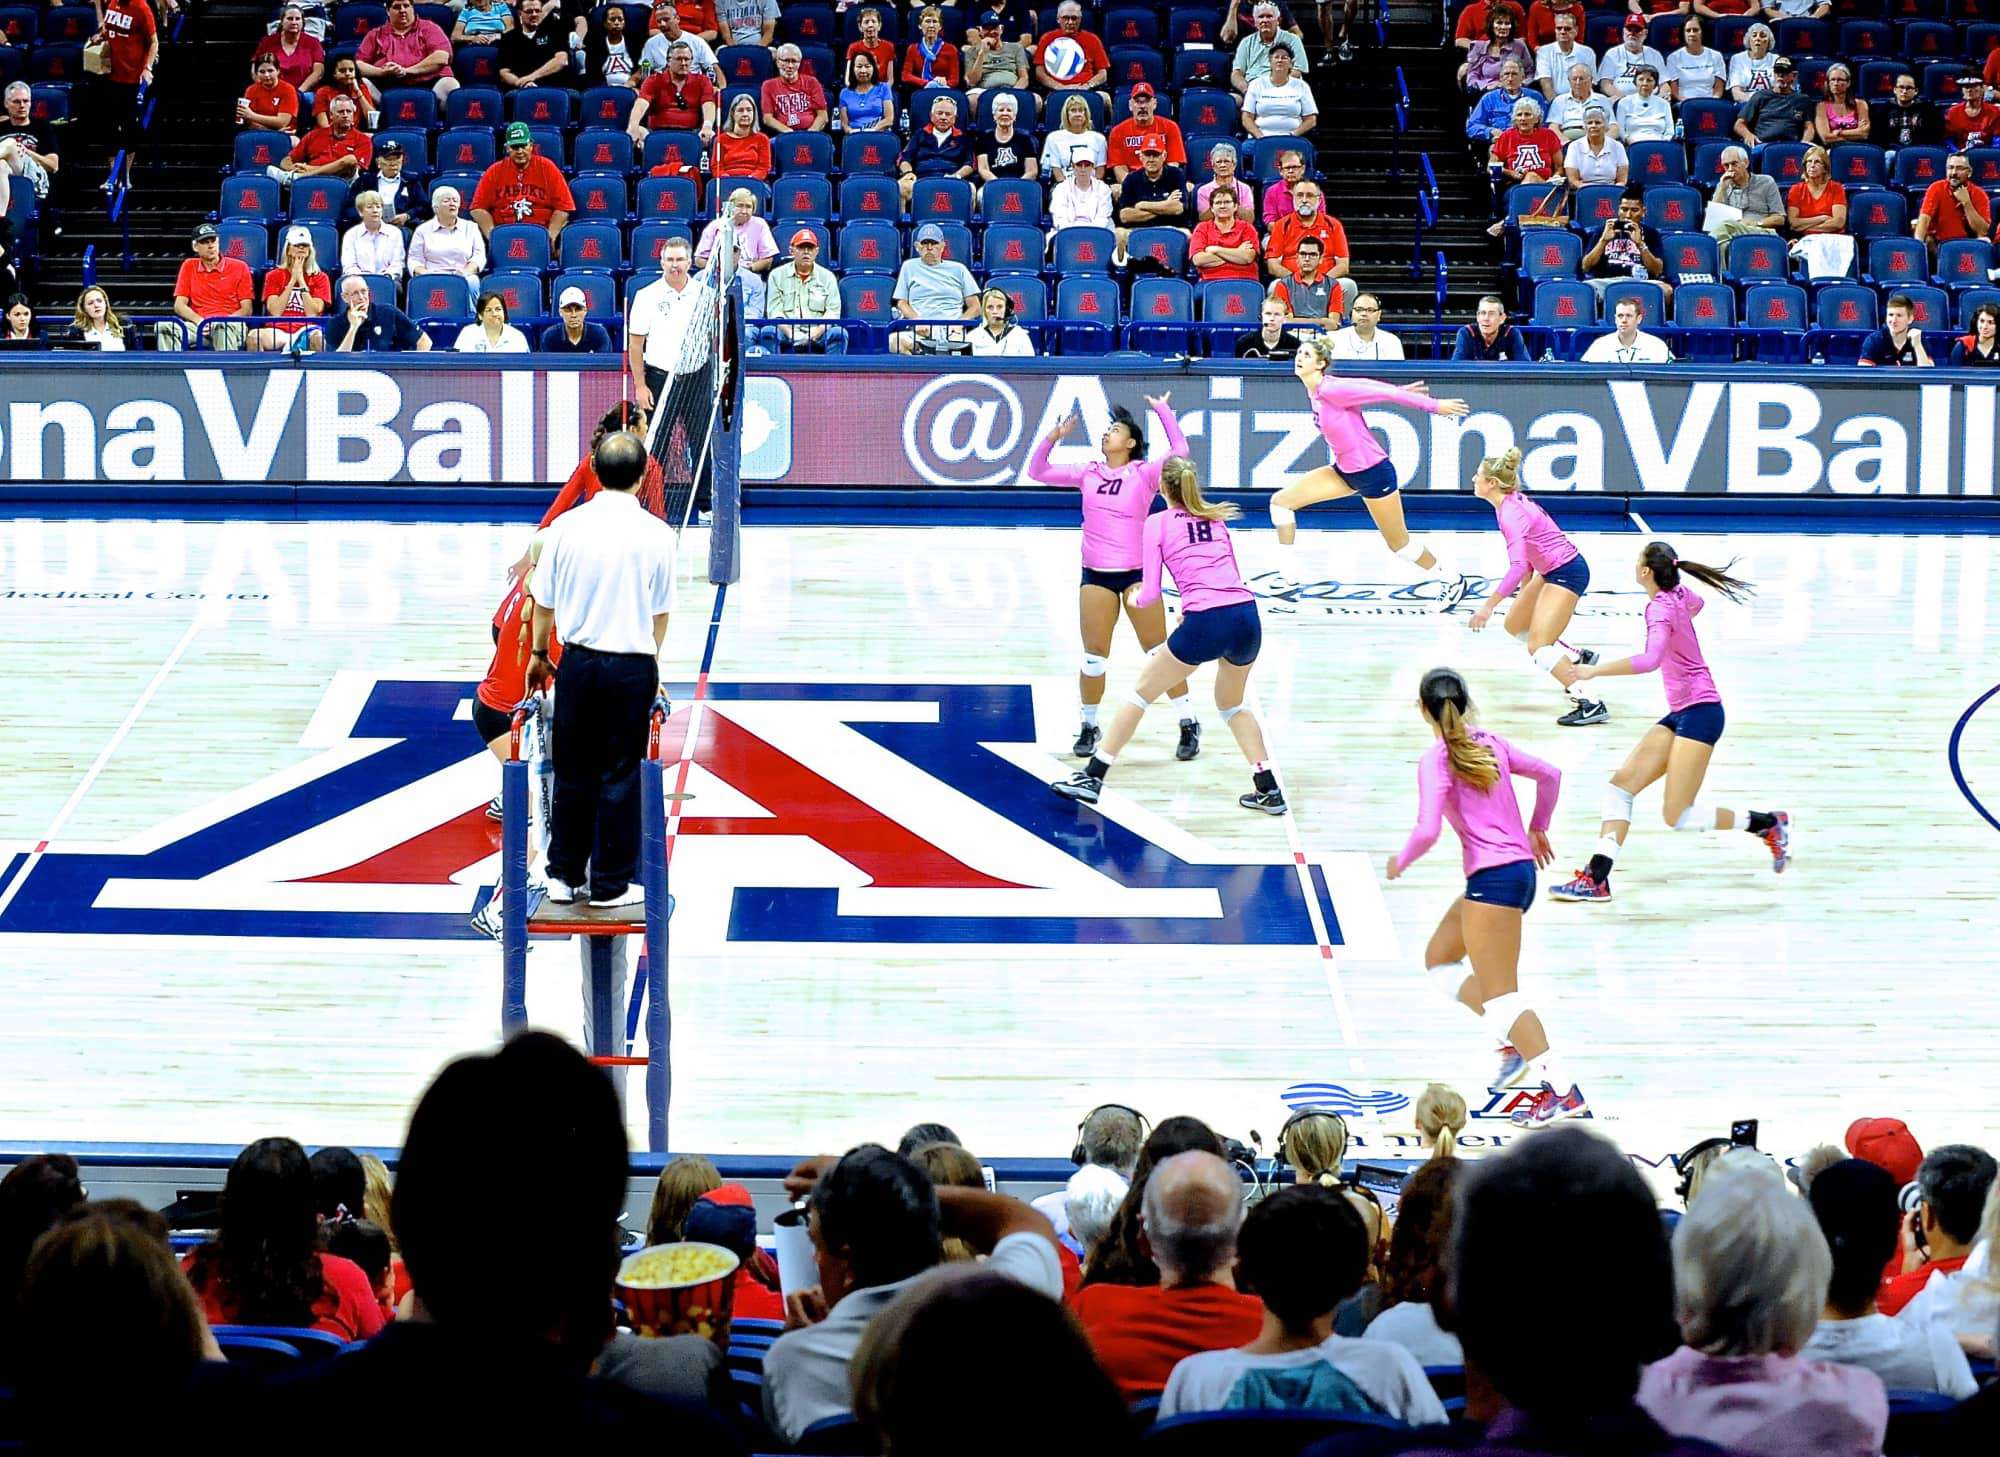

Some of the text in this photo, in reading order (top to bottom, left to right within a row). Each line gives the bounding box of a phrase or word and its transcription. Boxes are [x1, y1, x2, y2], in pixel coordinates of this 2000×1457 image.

[1512, 144, 1545, 170] A
[0, 368, 580, 482] naVBall
[1096, 478, 1123, 496] 20
[1186, 520, 1213, 544] 18
